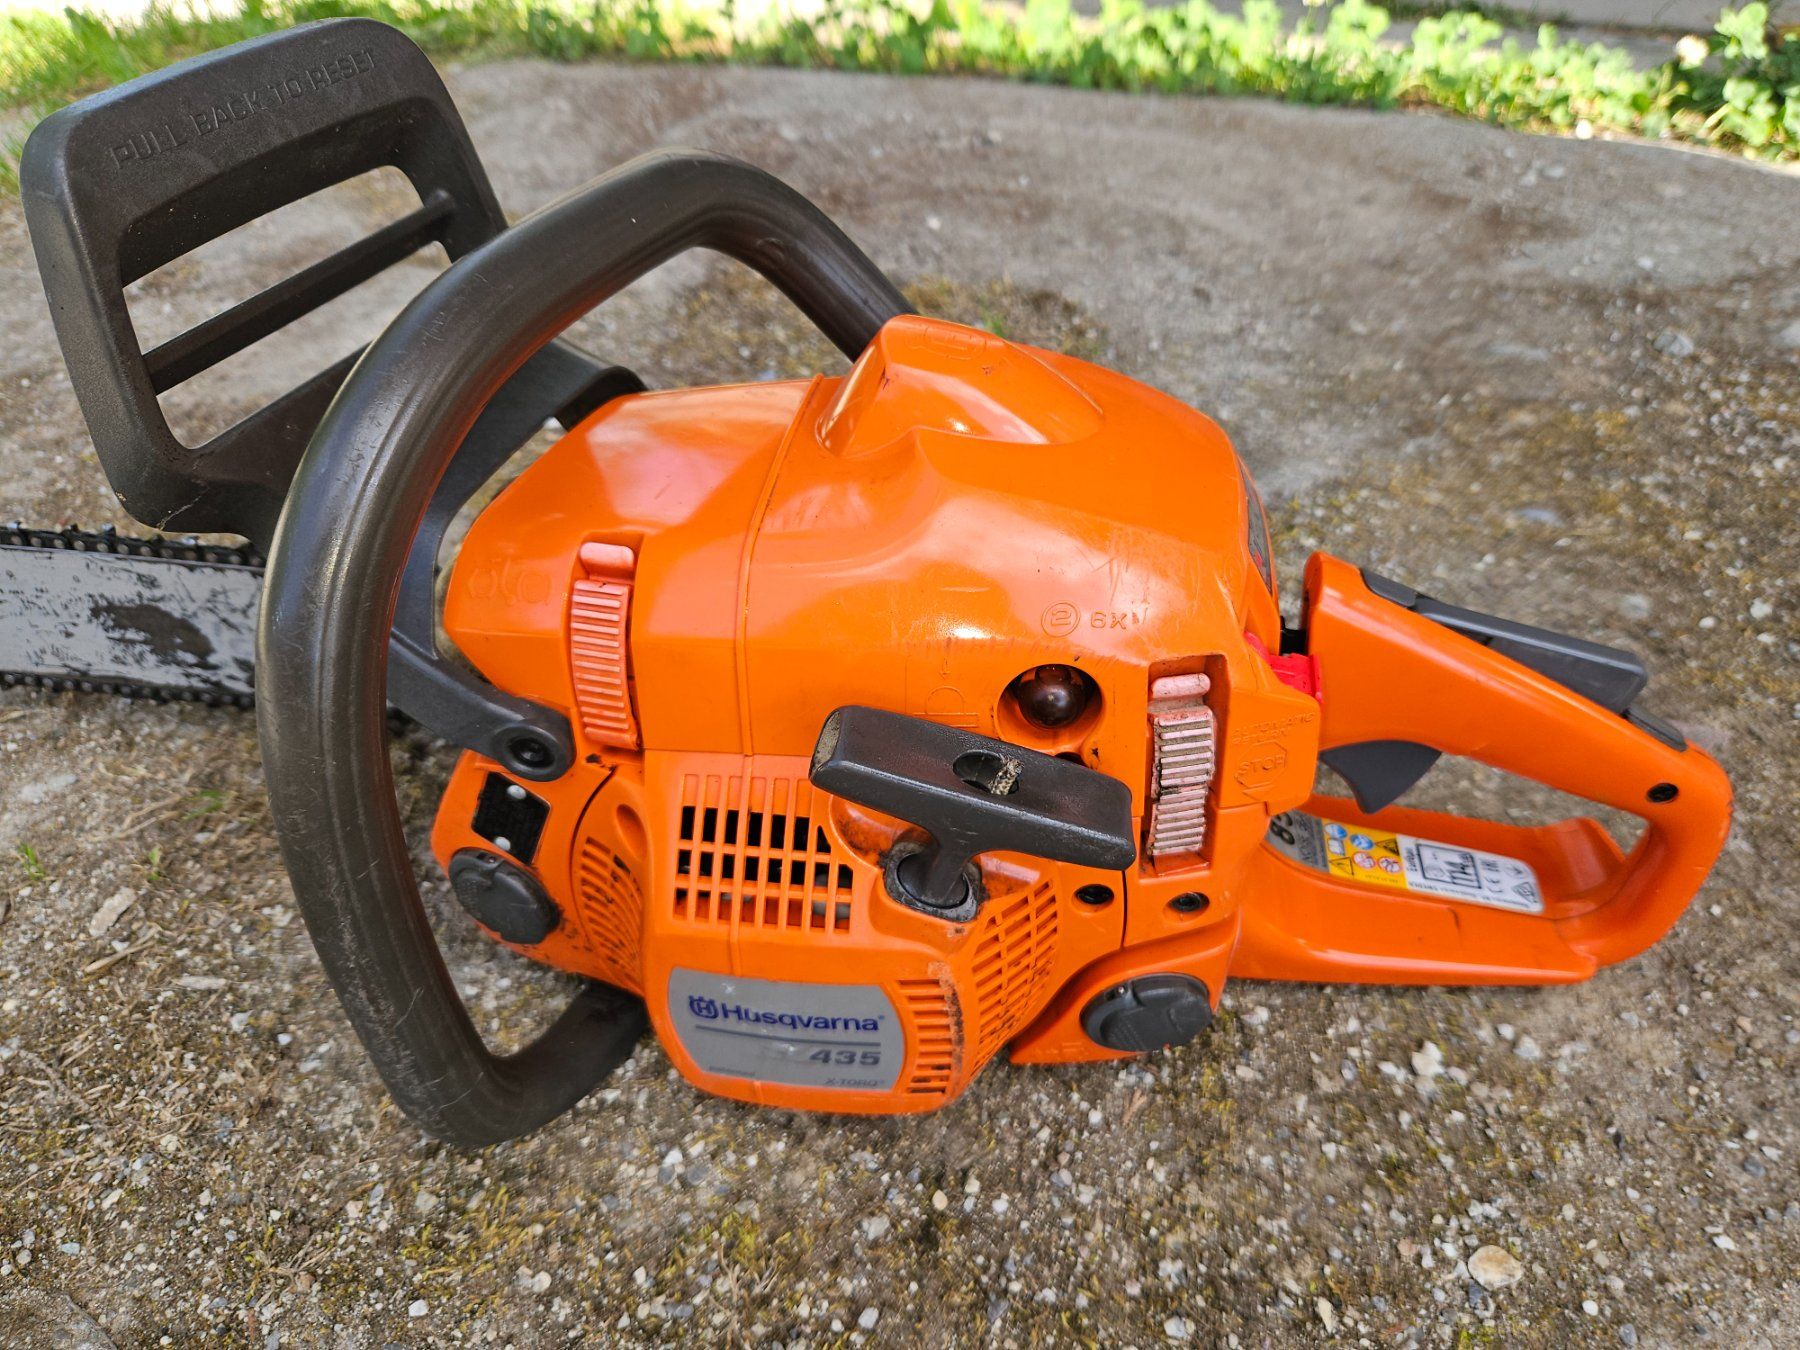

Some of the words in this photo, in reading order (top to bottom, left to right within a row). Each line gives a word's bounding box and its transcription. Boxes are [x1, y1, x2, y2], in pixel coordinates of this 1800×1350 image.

[109, 124, 189, 170] PULL
[189, 89, 270, 136] BACK
[266, 79, 303, 105] TO
[305, 49, 376, 91] RESET
[1237, 753, 1286, 776] STOP
[721, 1002, 880, 1031] Husqvarna
[809, 1050, 882, 1066] 435
